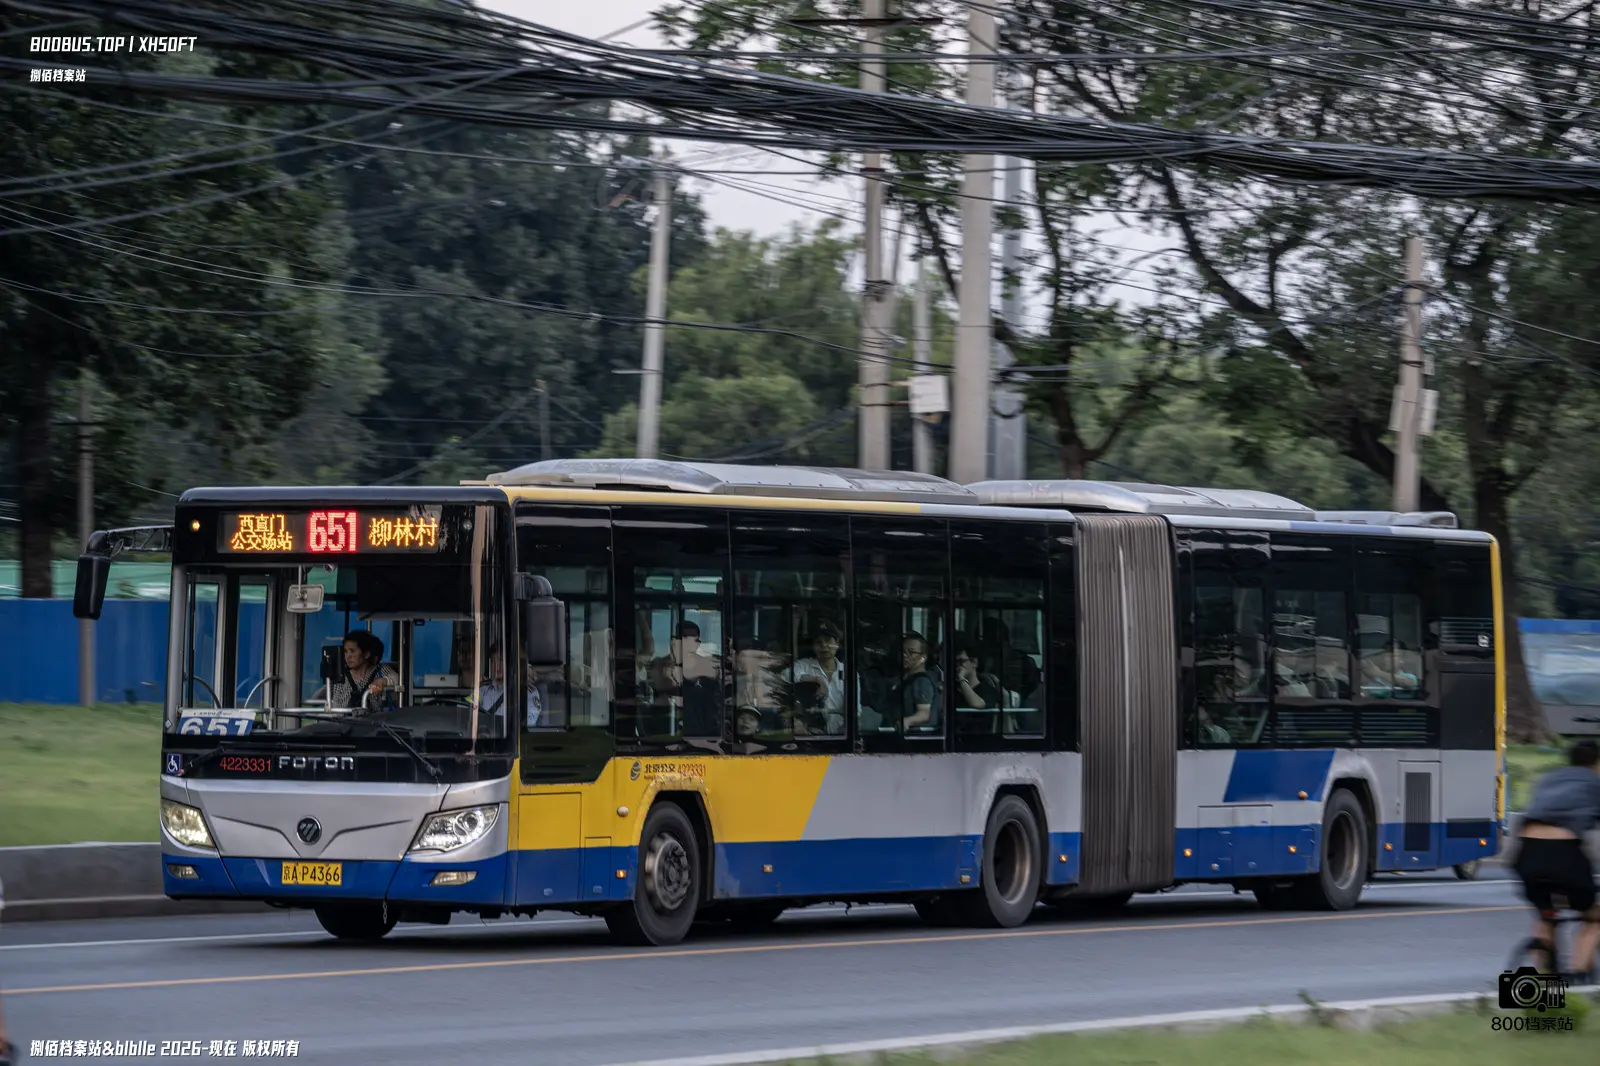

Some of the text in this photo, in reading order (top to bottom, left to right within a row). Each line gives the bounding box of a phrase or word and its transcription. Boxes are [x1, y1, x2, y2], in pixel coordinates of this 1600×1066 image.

[238, 514, 285, 533] 西直门
[309, 511, 357, 552] 651
[368, 517, 438, 547] 柳林村
[231, 531, 293, 551] 公交场站
[219, 756, 272, 773] 4223331
[279, 756, 355, 771] FOTON
